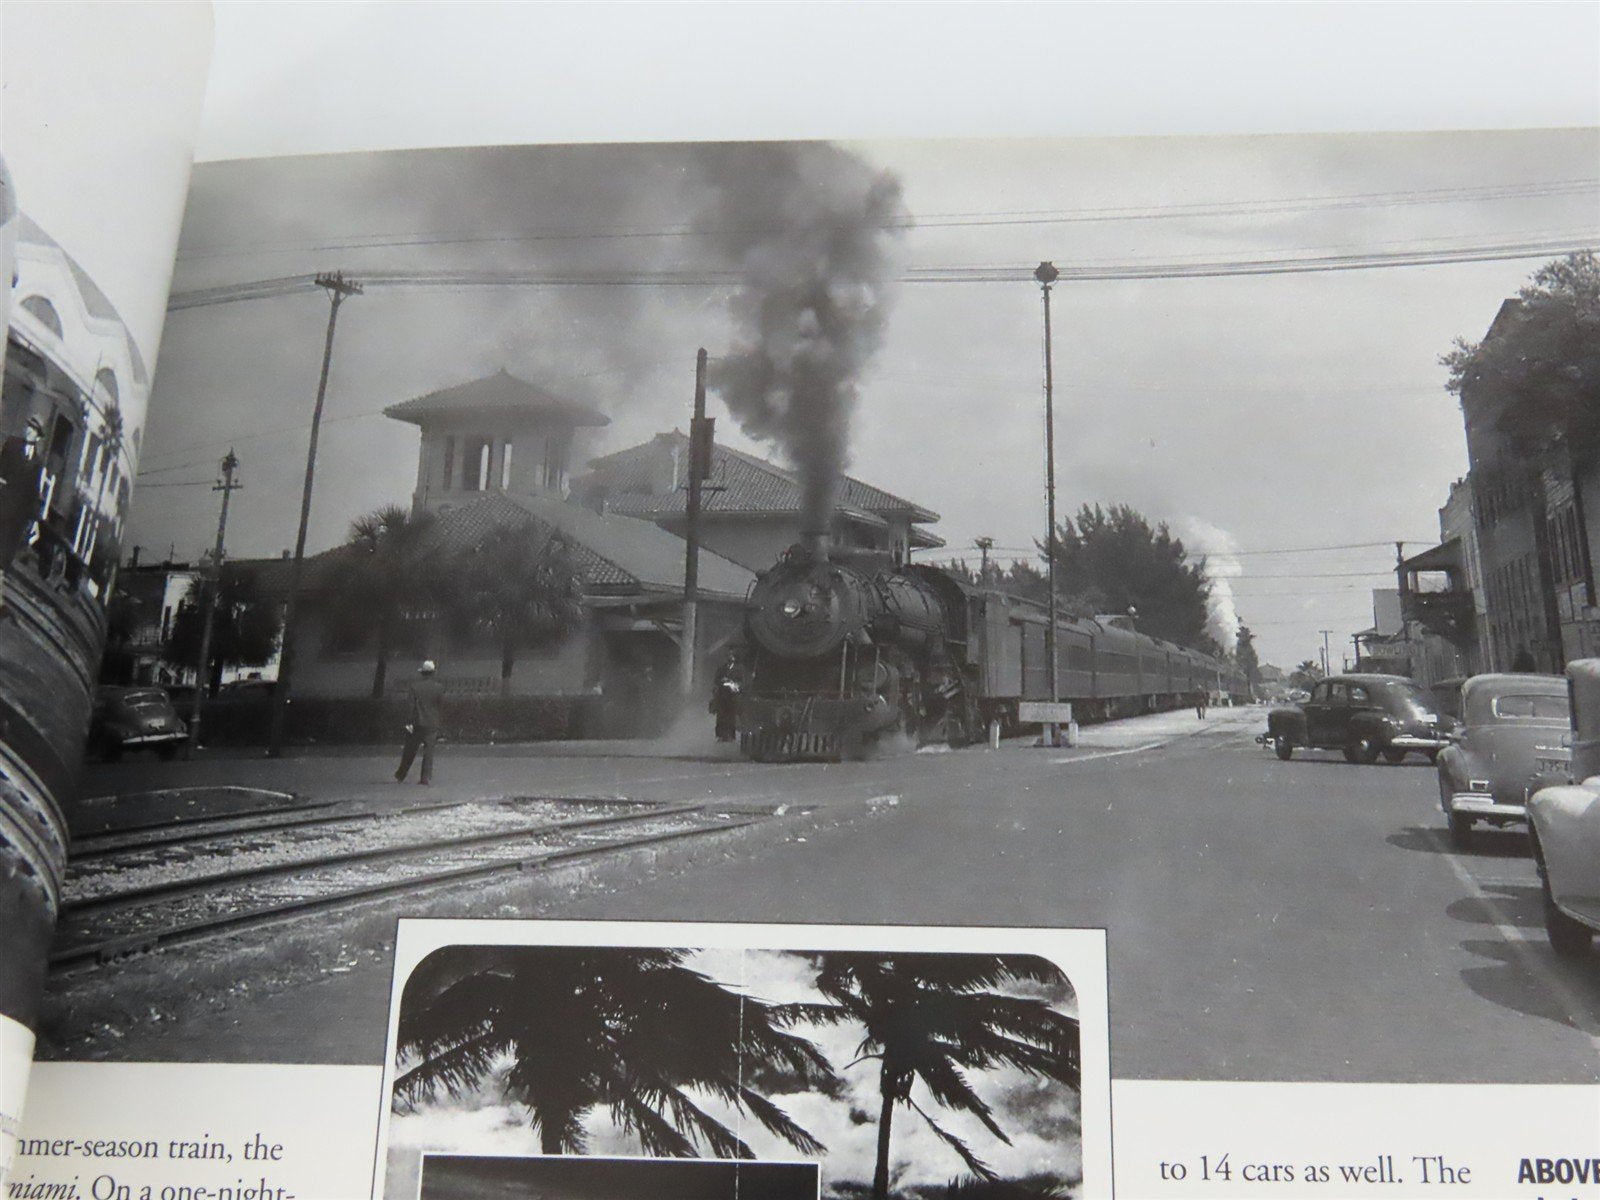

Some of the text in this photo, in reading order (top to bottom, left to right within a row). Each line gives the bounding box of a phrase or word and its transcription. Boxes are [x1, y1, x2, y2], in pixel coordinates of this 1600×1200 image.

[169, 1133, 233, 1163] train,
[243, 1133, 283, 1160] the
[1160, 1153, 1471, 1184] to 14 cars as well. The
[92, 1174, 131, 1200] On
[140, 1185, 152, 1200] a
[161, 1177, 295, 1200] one-night-
